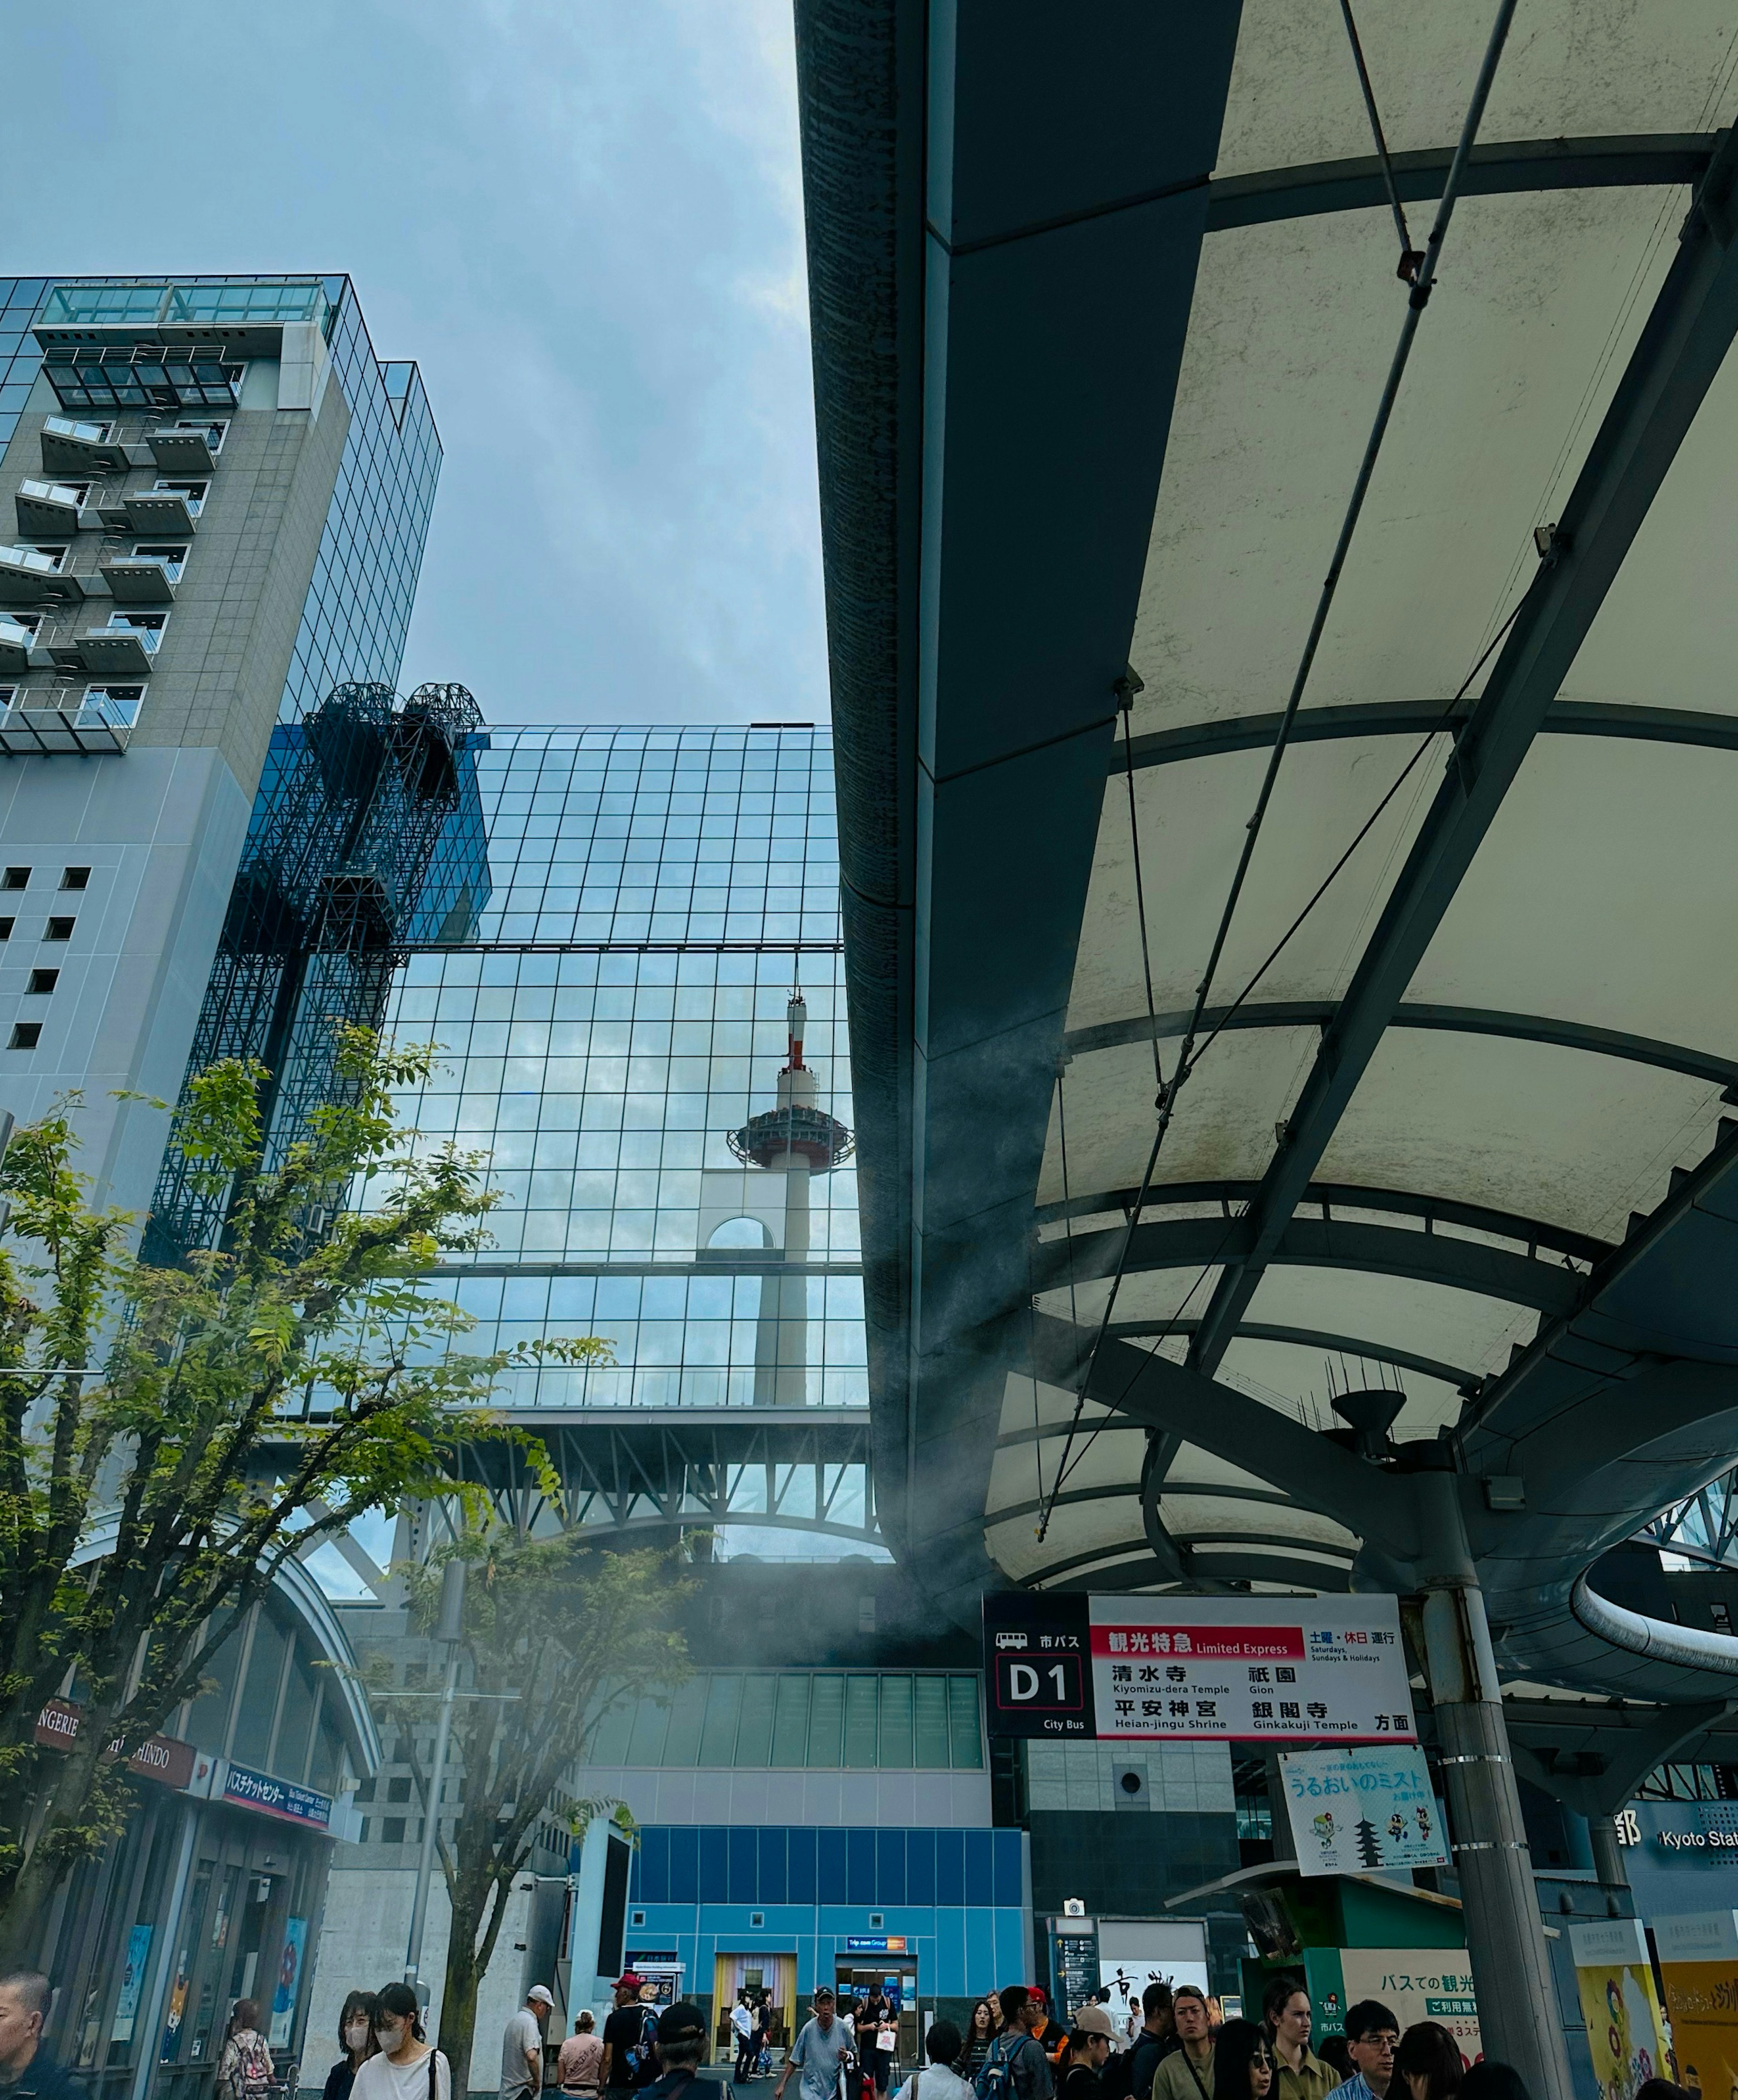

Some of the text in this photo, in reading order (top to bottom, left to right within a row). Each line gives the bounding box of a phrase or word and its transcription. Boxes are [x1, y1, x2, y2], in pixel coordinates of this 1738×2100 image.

[1040, 1635, 1079, 1648] 市バス
[1108, 1632, 1193, 1653] 観光特急
[1197, 1643, 1288, 1656] Limited Express
[1311, 1646, 1347, 1654] Saturdays,
[1313, 1655, 1341, 1663] Sundays
[1350, 1655, 1380, 1663] Holidays
[1113, 1665, 1186, 1682] 清水寺
[1248, 1667, 1296, 1683] 祇園
[1010, 1664, 1065, 1700] D1
[1113, 1685, 1230, 1695] Kiyomizu-dera Temple
[1115, 1700, 1216, 1717] 平安神宮
[1252, 1702, 1327, 1718] 銀閣寺
[1044, 1719, 1084, 1731] City Bus
[1115, 1719, 1227, 1729] Heian-jingu Shrine
[1253, 1721, 1358, 1731] Ginkakuji Temple
[1374, 1714, 1409, 1730] 方面
[227, 1771, 285, 1804] バスチケットセンター
[1291, 1770, 1422, 1798] うるおいのミスト
[1662, 1831, 1705, 1850] Kyoto
[1320, 2023, 1345, 2032] 市バス
